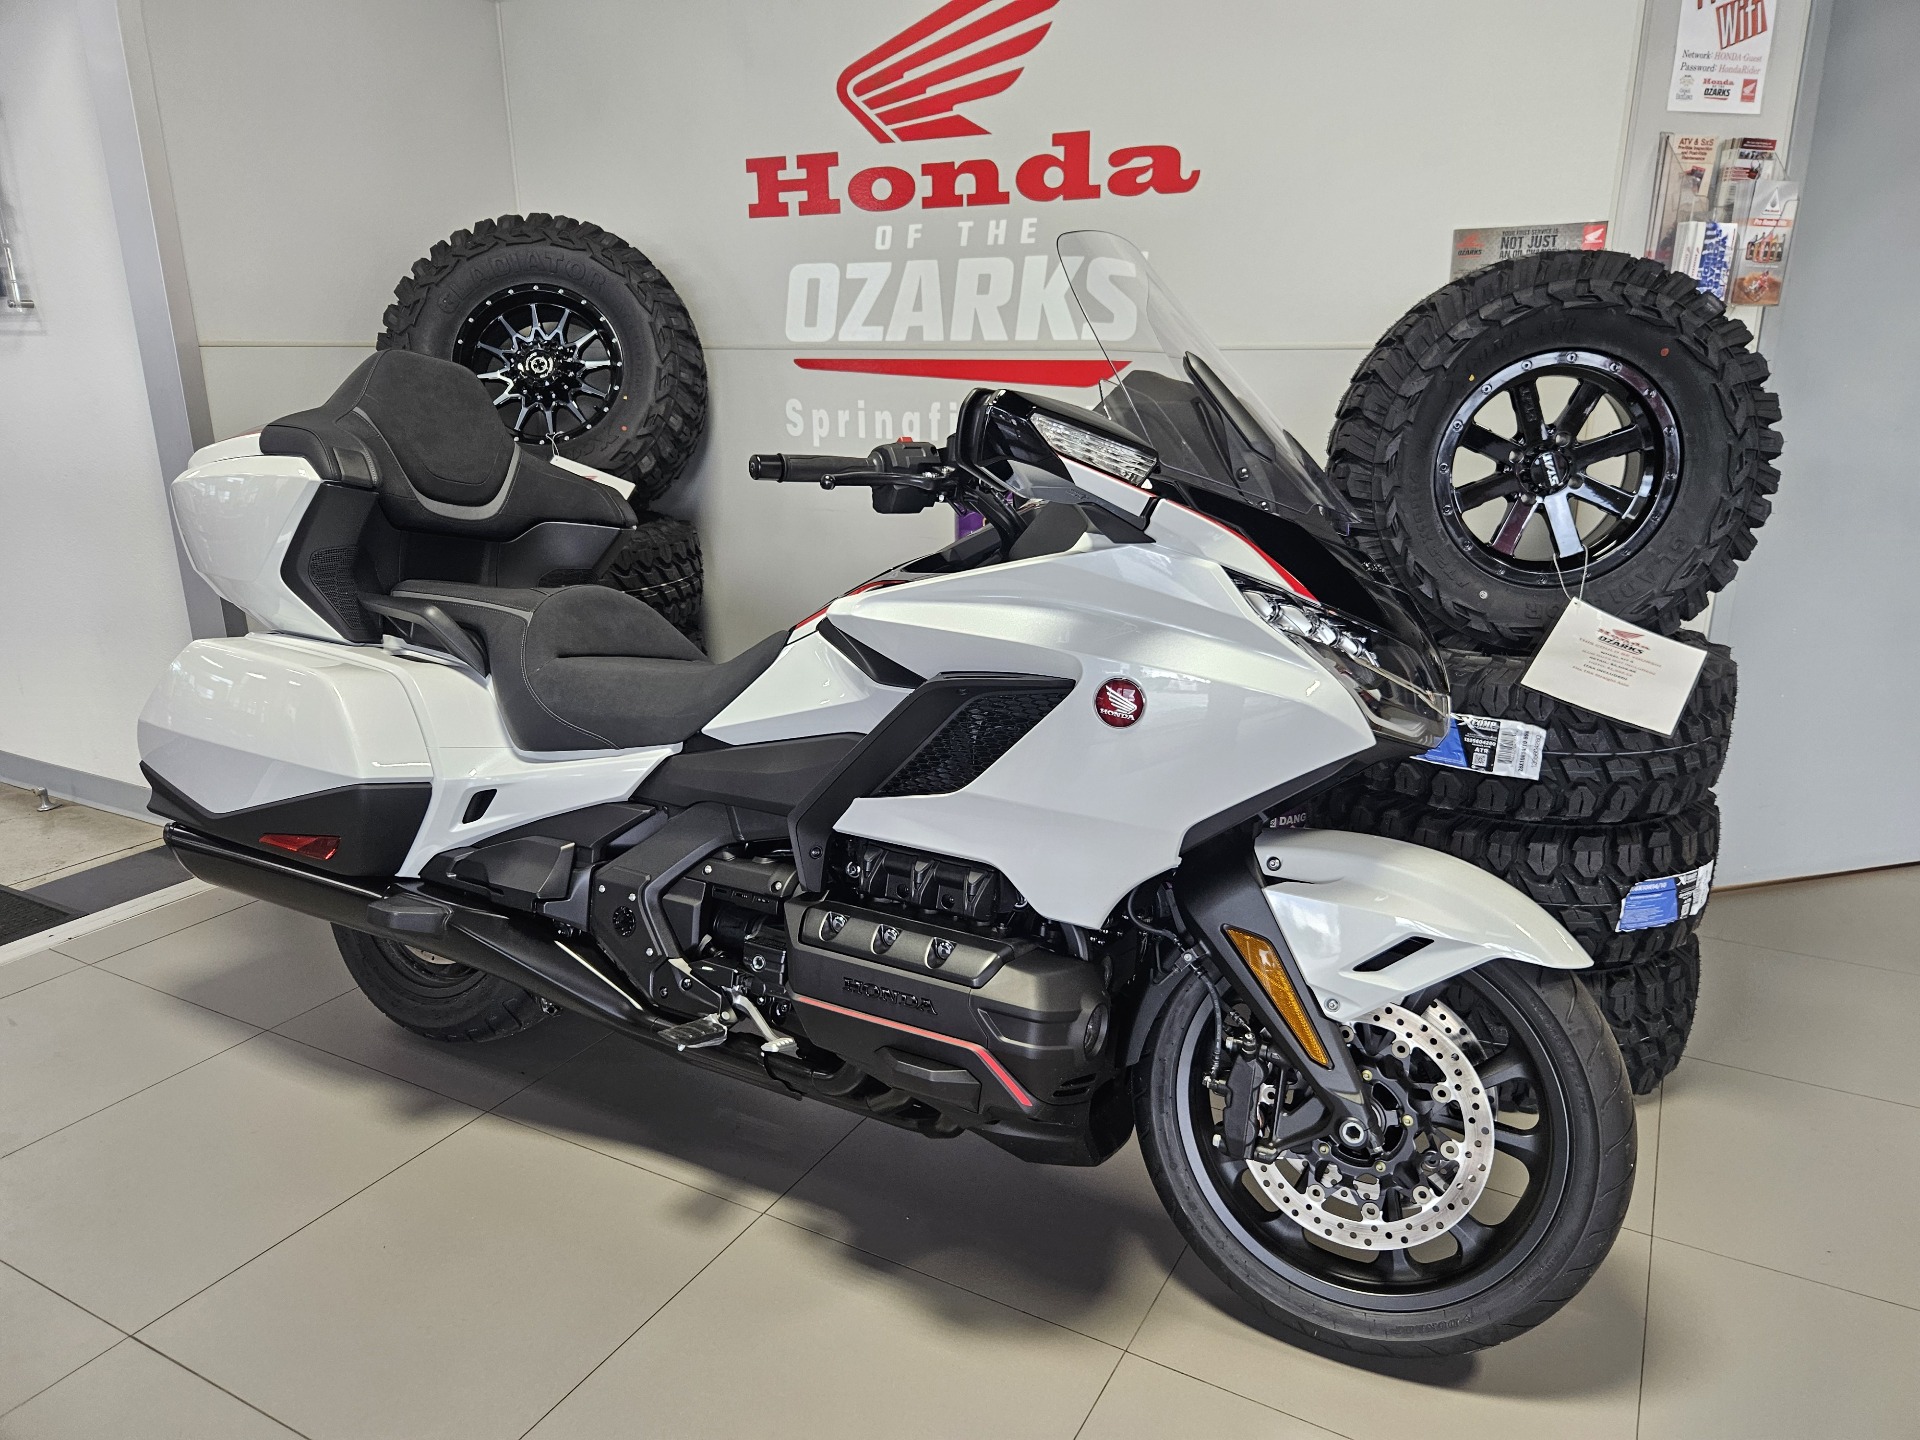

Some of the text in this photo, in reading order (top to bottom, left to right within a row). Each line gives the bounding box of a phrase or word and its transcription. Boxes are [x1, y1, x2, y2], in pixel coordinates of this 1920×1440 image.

[1682, 49, 1713, 60] Network:
[1714, 52, 1741, 61] HONDA
[1680, 62, 1717, 73] Password:
[1704, 88, 1731, 97] OZARKS
[1680, 137, 1692, 145] ATV
[746, 130, 1200, 218] Honda
[874, 217, 1038, 250] OF THE
[1501, 236, 1524, 250] NOT
[1528, 235, 1558, 249] JUST
[436, 249, 608, 313] GLADIATOR
[785, 256, 1138, 342] OZARKS
[784, 398, 957, 447] Springfi
[1598, 635, 1643, 655] OZARKS
[1100, 708, 1135, 721] HONDA
[842, 977, 938, 1015] HONDA
